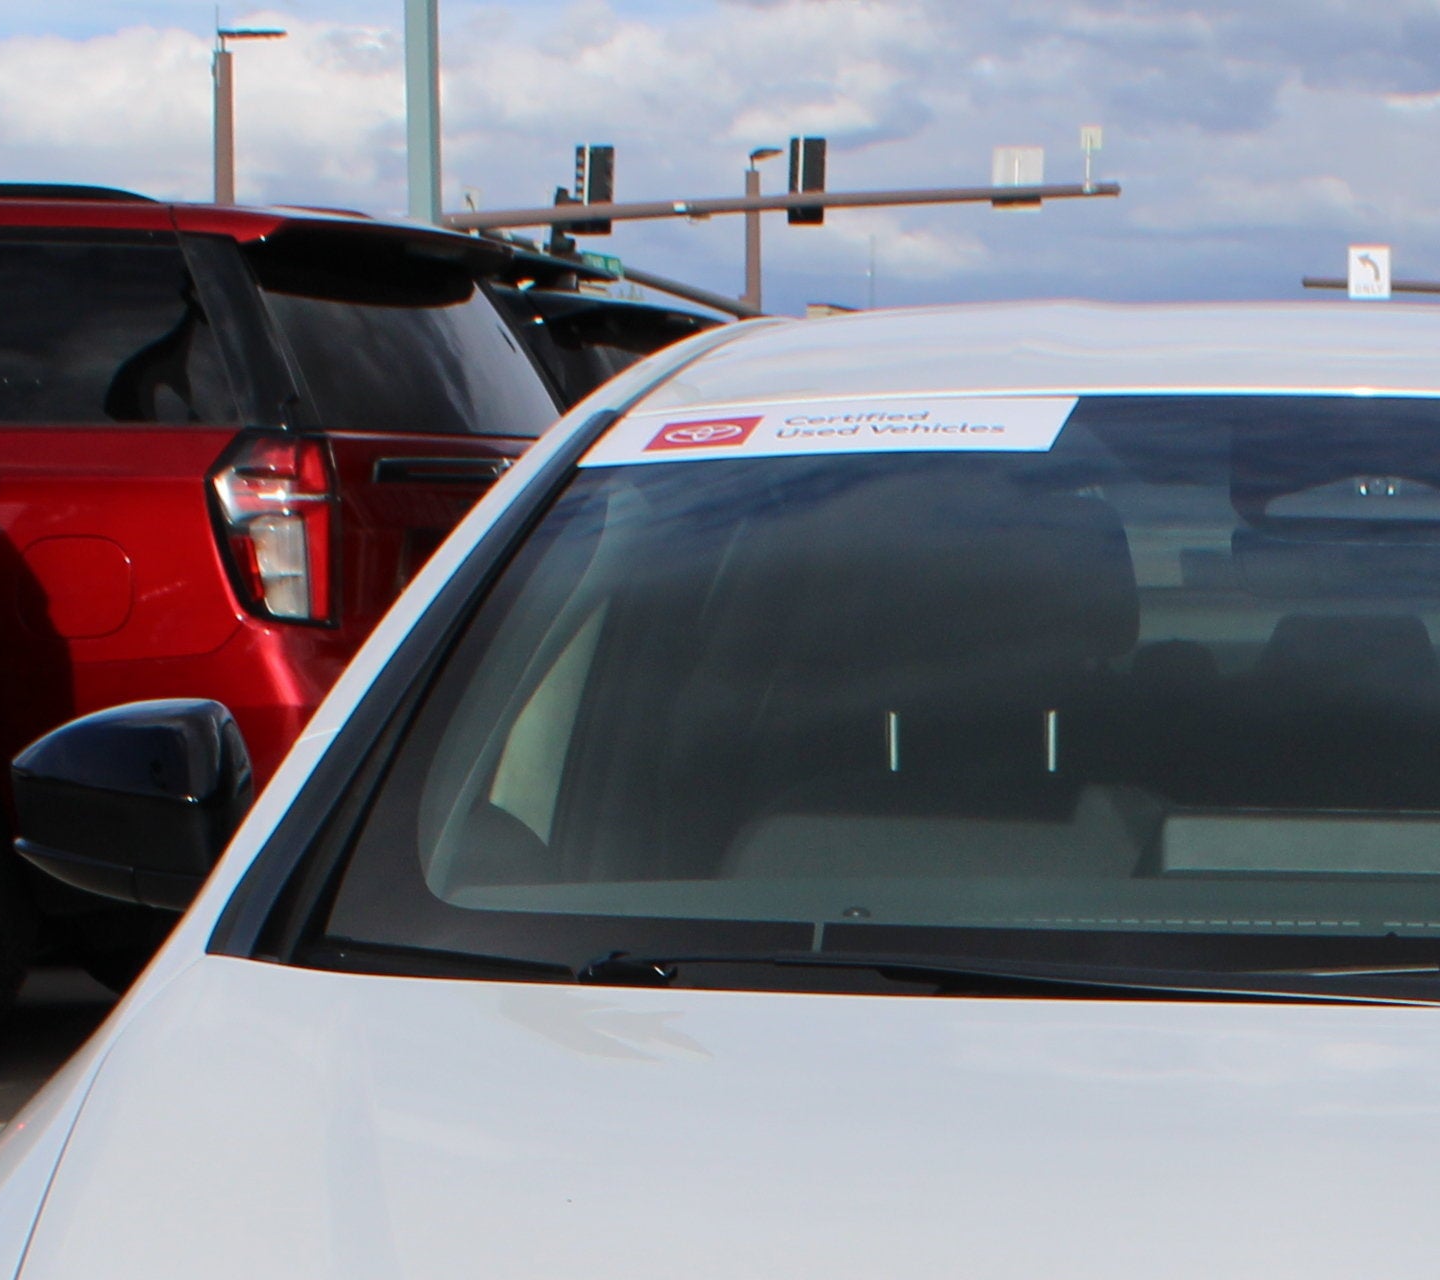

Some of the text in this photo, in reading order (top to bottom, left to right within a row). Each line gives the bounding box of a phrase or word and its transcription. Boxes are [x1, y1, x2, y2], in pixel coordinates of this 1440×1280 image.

[786, 411, 929, 425] Certified
[776, 423, 1005, 438] Used Vehicles
